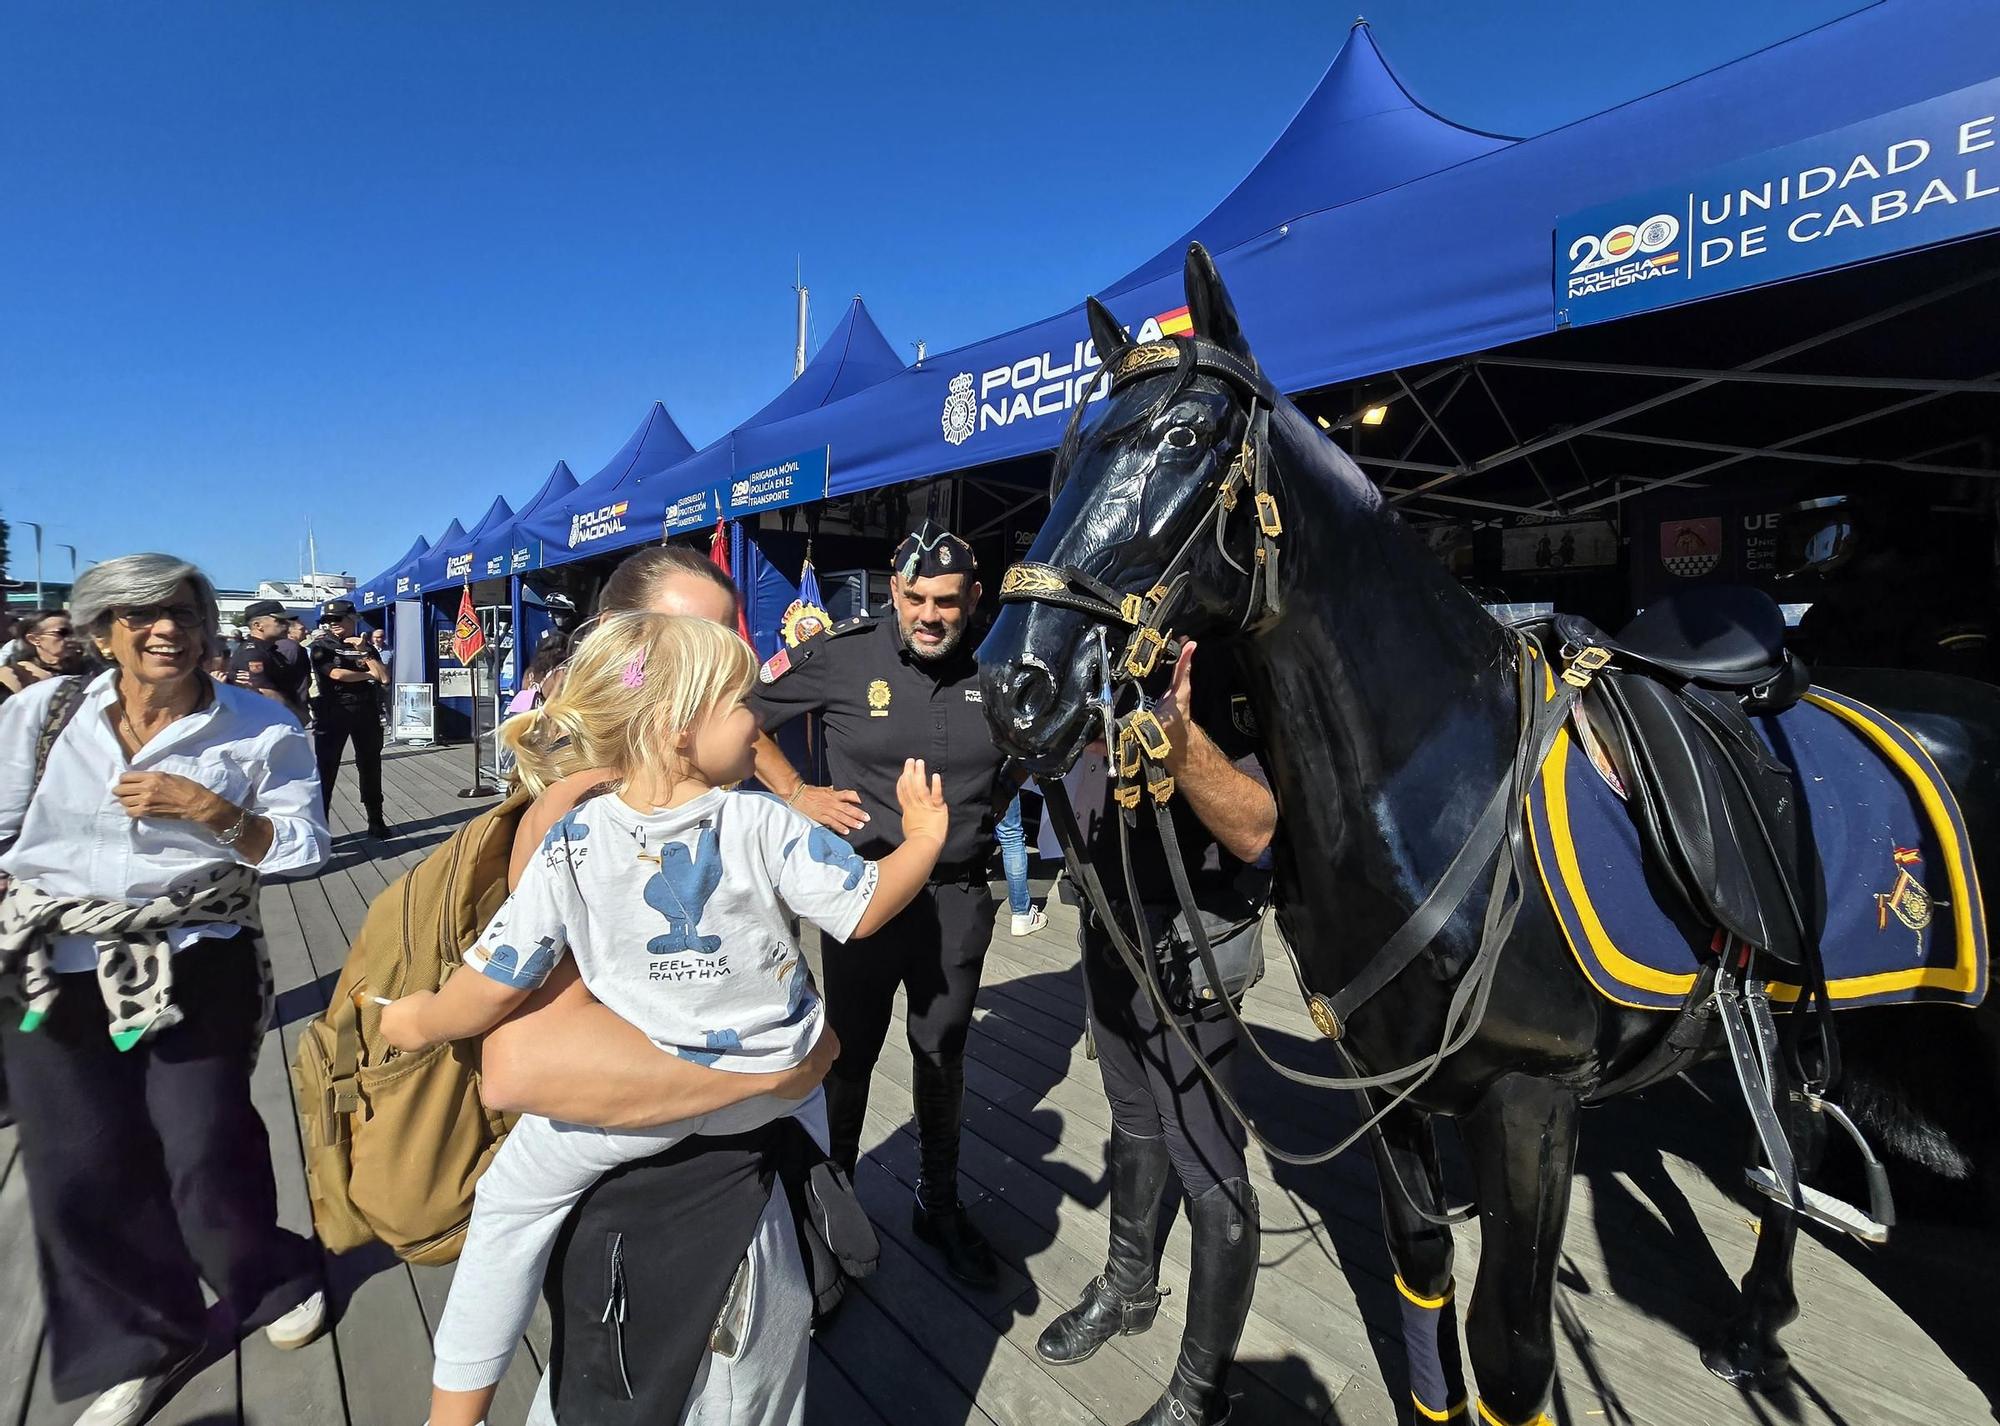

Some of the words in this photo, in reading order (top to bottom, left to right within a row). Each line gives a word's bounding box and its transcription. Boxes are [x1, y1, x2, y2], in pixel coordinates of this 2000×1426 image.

[1701, 138, 1931, 225] UNIDAD
[1959, 115, 1996, 155] E
[1701, 225, 1767, 268] DE
[1787, 168, 2000, 243] CABAL
[1568, 213, 1680, 275] 200
[1568, 259, 1655, 289] POLICIA
[1568, 265, 1679, 299] NACIONAL
[980, 316, 1164, 400] POLICA
[980, 369, 1114, 432] NACIO
[751, 467, 778, 482] BRIGADA
[779, 461, 800, 475] MÓVIL
[750, 479, 775, 495] POLICÍA
[775, 478, 785, 489] EN
[785, 476, 794, 487] EL
[750, 489, 789, 506] TRANSPORTE
[580, 504, 616, 529] POLICIA
[577, 518, 627, 543] NACIONAL
[648, 967, 731, 981] RHYTHM
[649, 959, 693, 971] FEEL
[695, 954, 728, 968] THE
